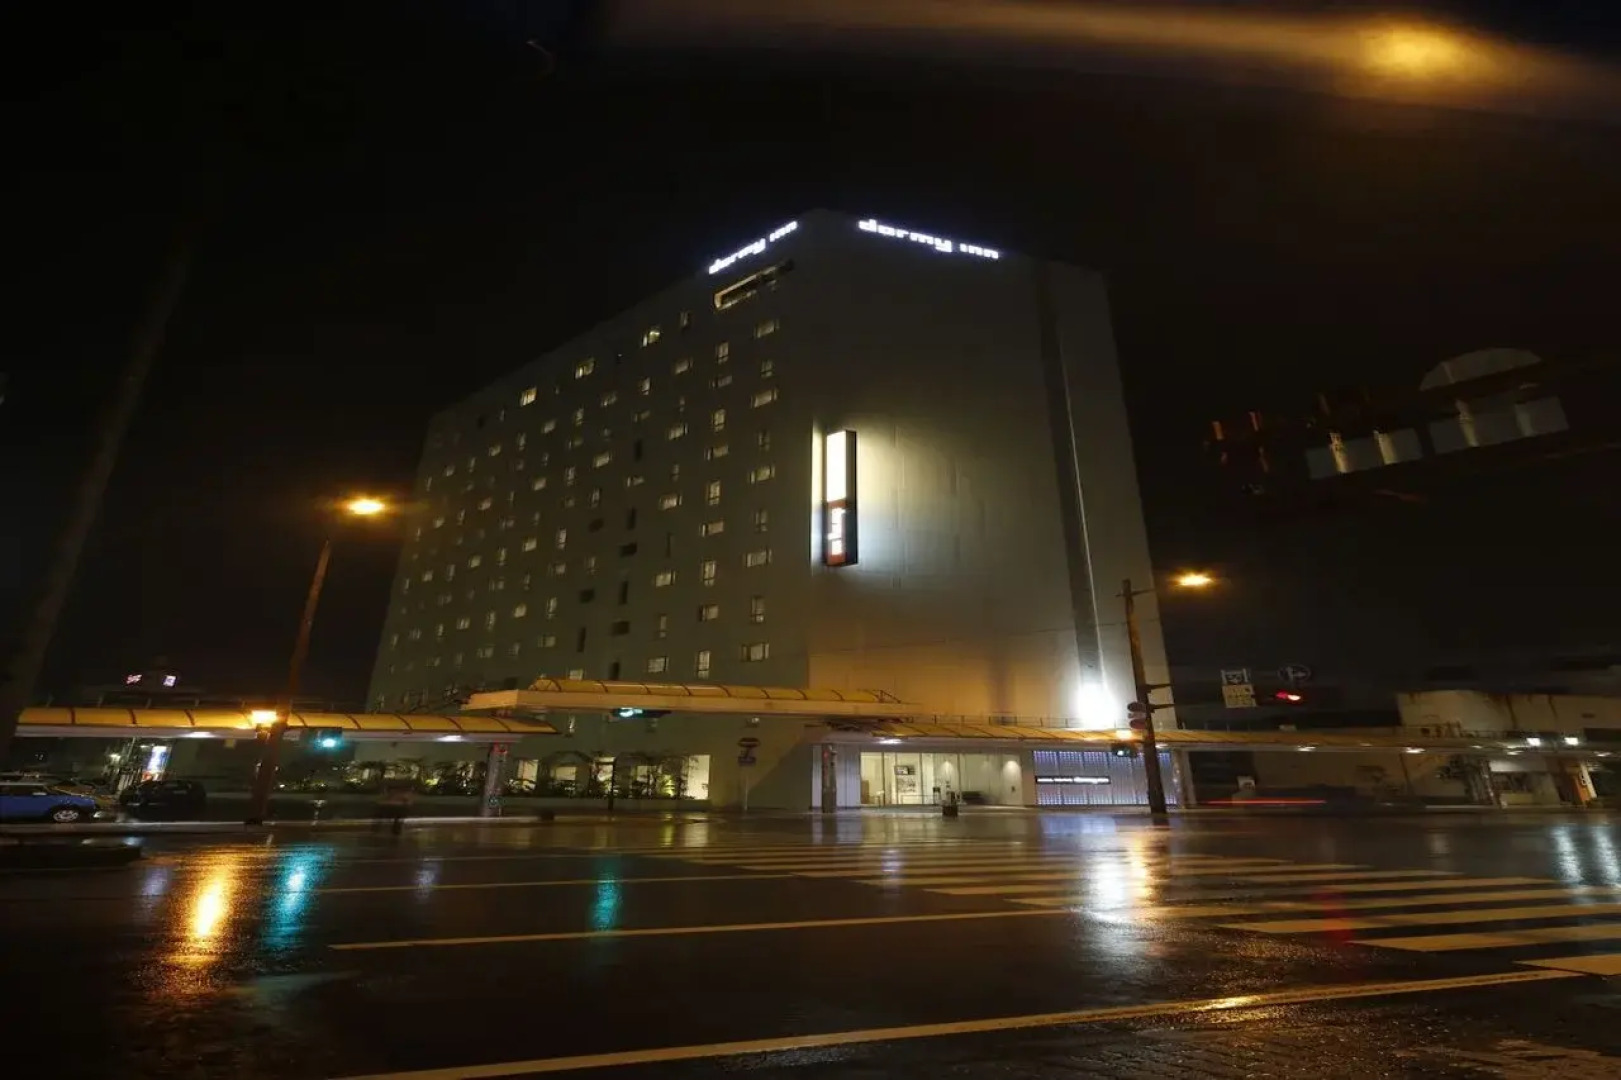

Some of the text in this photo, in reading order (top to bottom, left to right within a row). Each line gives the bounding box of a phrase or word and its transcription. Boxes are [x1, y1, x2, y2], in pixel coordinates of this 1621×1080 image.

[708, 221, 798, 274] dormy inn
[858, 219, 999, 259] dormy inn
